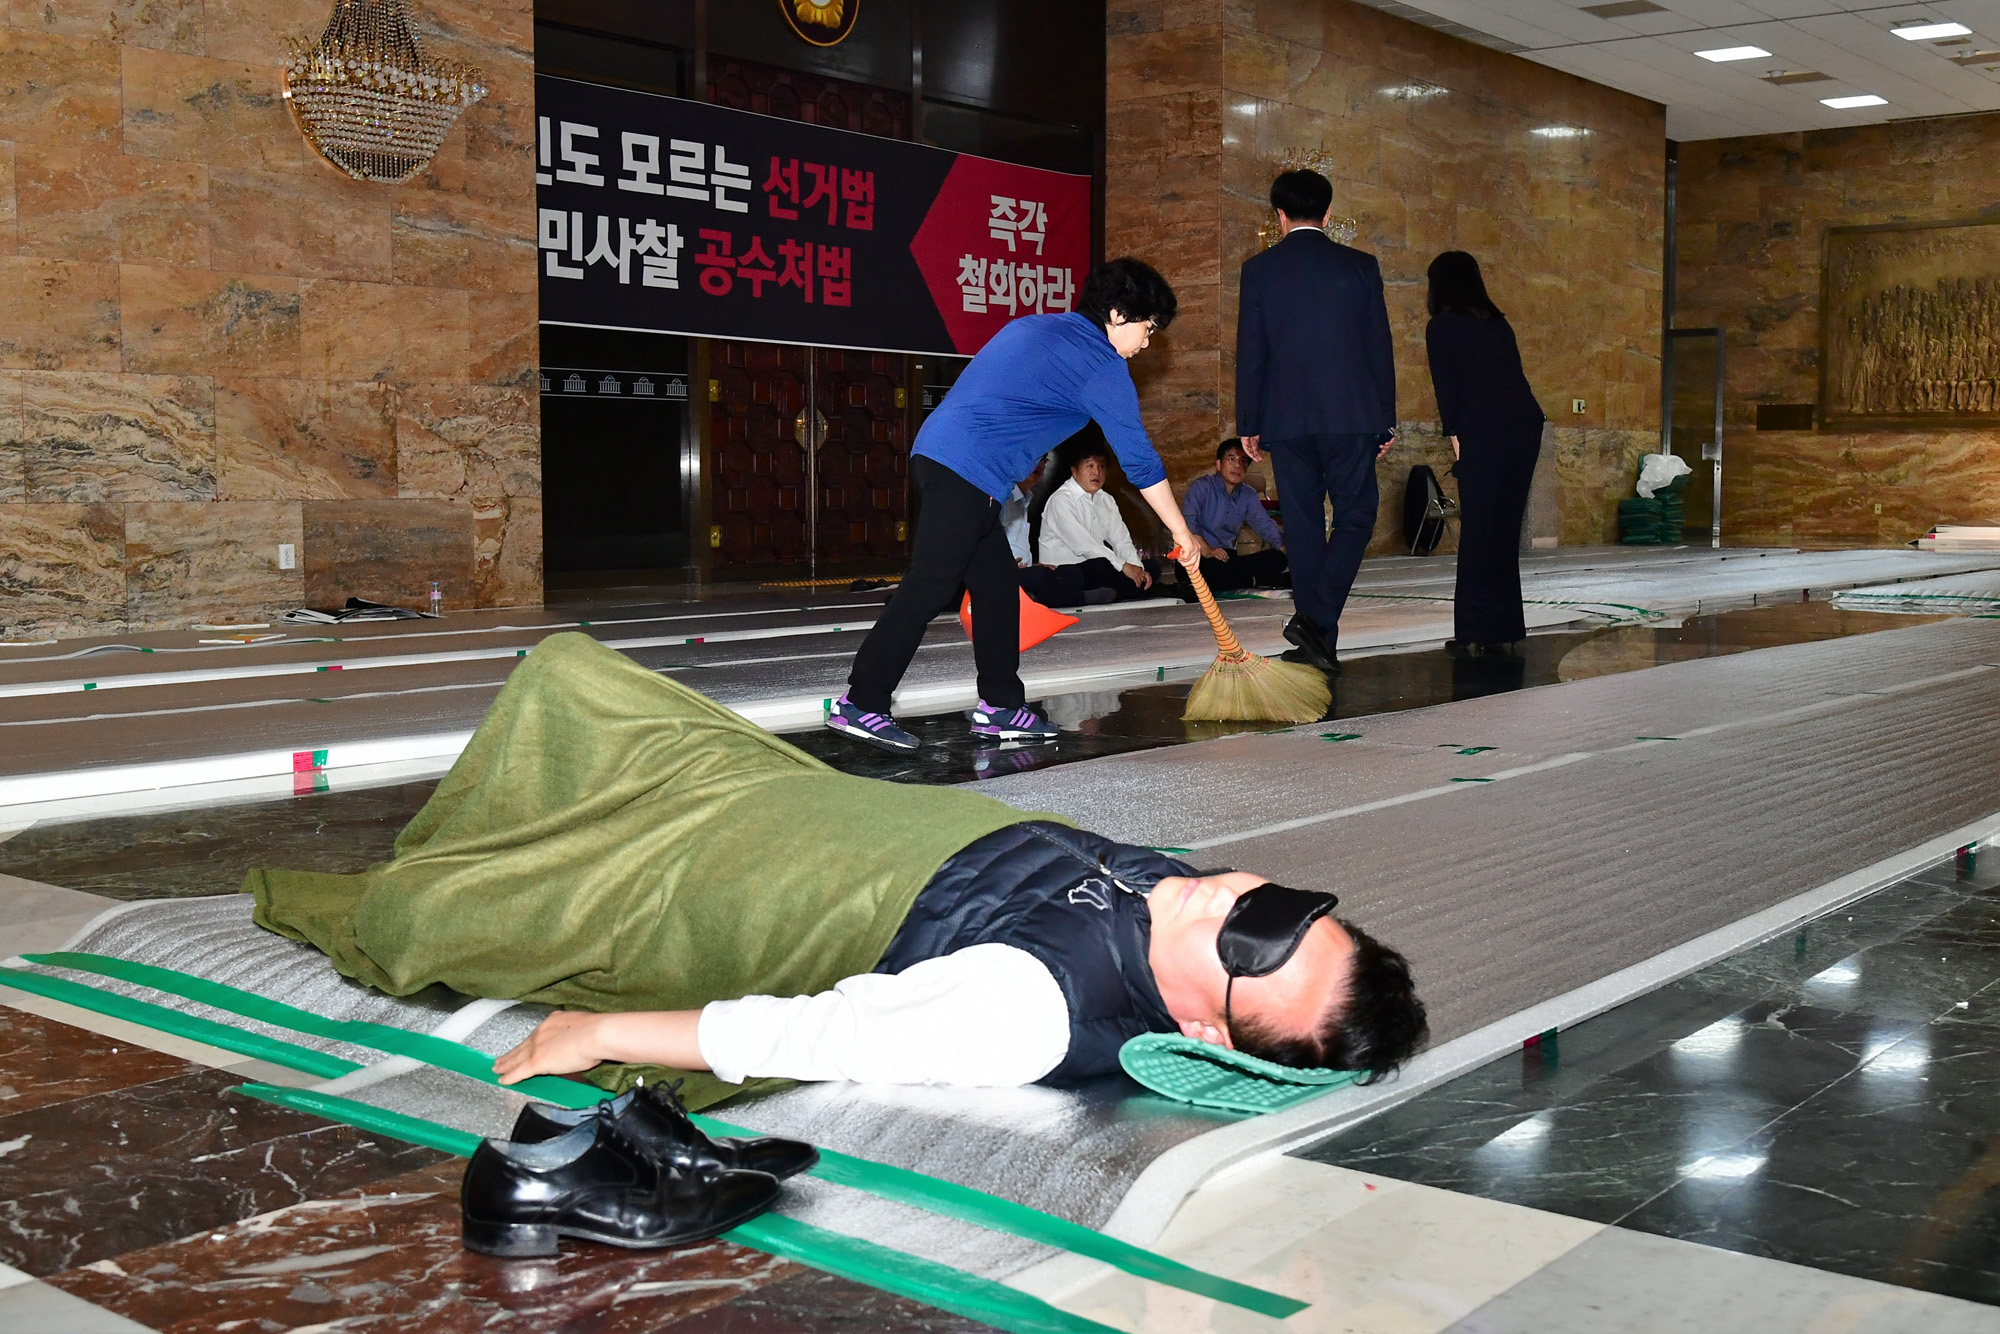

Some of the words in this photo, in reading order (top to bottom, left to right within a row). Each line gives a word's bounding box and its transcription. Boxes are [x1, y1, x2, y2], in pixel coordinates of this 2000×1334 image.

[618, 131, 752, 213] 모르는
[762, 156, 875, 231] 선거법
[538, 208, 685, 289] 민사찰
[694, 228, 852, 307] 공수처법
[988, 194, 1048, 256] 즉각
[956, 253, 1076, 316] 철회하라
